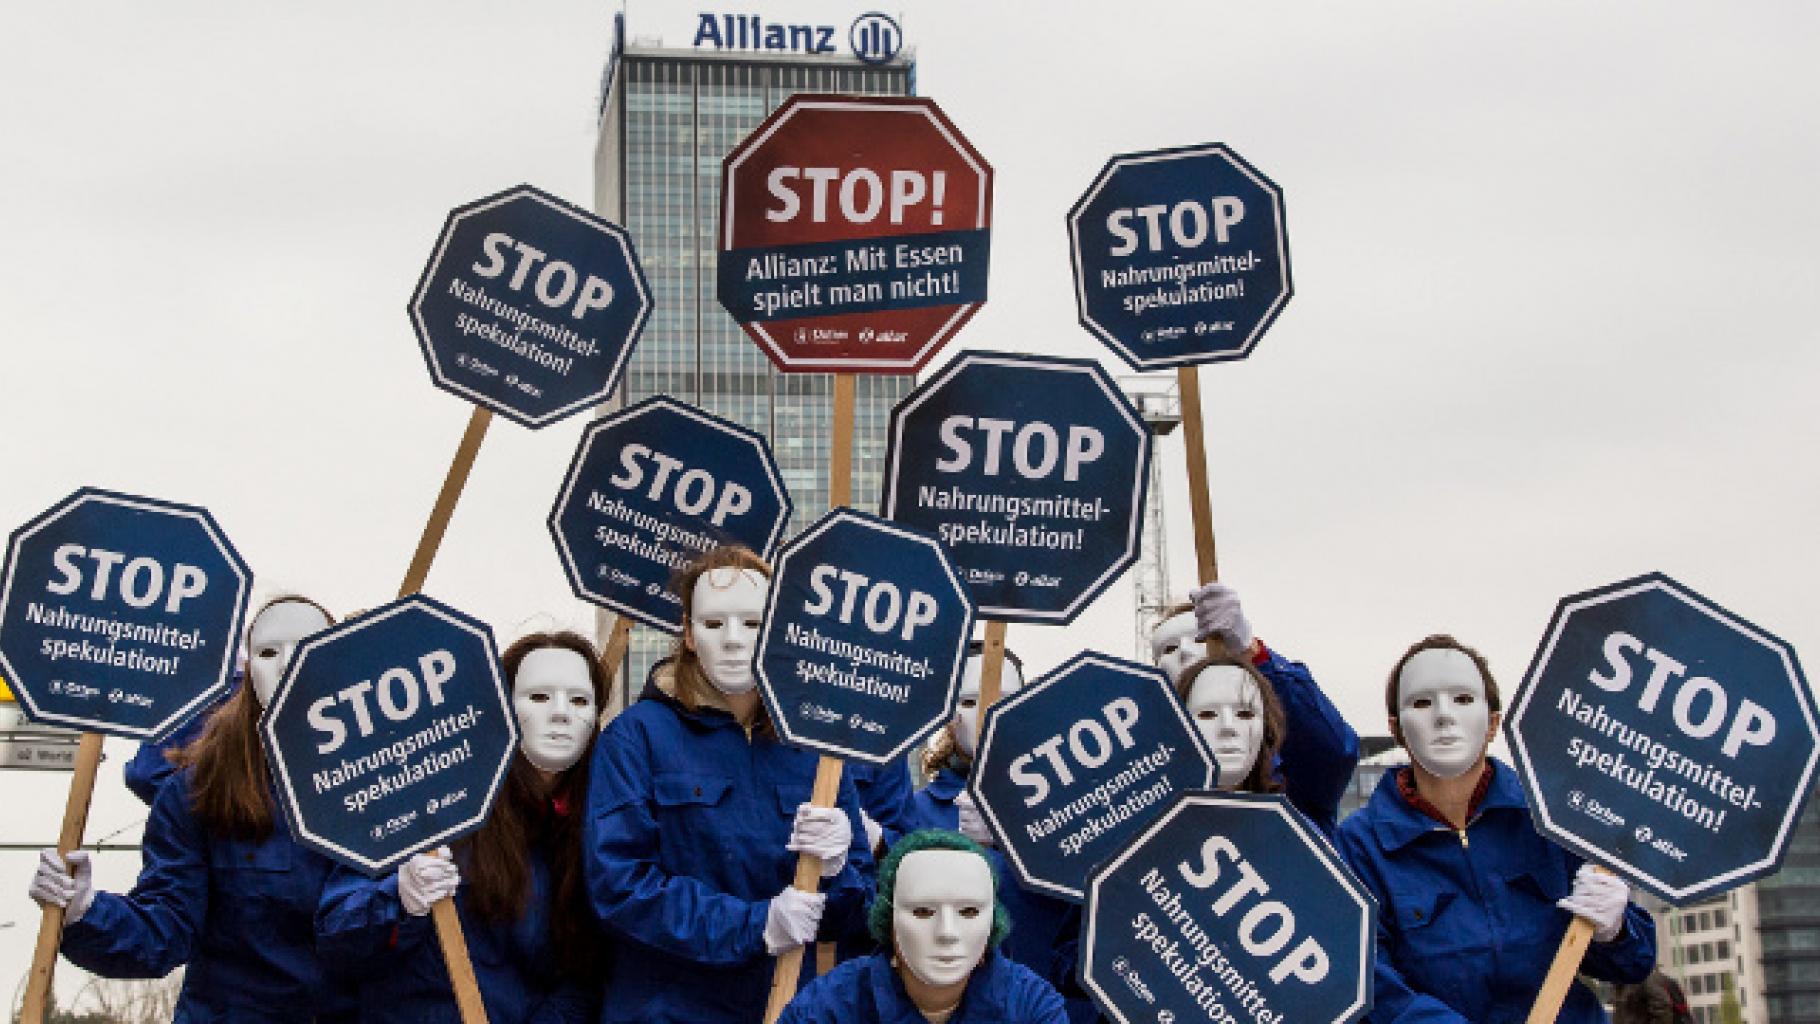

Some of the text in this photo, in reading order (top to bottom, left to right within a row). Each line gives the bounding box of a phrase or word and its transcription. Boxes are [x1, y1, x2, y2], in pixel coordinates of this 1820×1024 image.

[693, 13, 836, 52] Allianz
[765, 166, 946, 226] STOP!
[1106, 195, 1246, 257] STOP
[472, 232, 615, 321] STOP
[745, 243, 963, 282] Allianz: Mit Essen
[752, 270, 960, 316] spielt man nicht!
[1101, 250, 1262, 288] Nahrungsmittel-
[448, 278, 600, 358] Nahrungsmittel-
[1123, 279, 1245, 316] spekulation!
[454, 312, 573, 376] spekulation!
[935, 414, 1105, 482] STOP
[609, 443, 752, 527] STOP
[918, 486, 1110, 521] Nahrungsmittel-
[586, 489, 717, 552] Nahrungsmitt
[939, 520, 1084, 551] spekulation!
[47, 543, 208, 614] STOP
[804, 564, 939, 641] STOP
[25, 602, 206, 650] Nahrungsmittel-
[40, 635, 180, 675] spekulation!
[784, 623, 934, 678] Nahrungsmittel-
[306, 648, 457, 755] STOP
[795, 659, 911, 704] spekulation!
[1587, 630, 1778, 759] STOP
[312, 705, 485, 795] Nahrungsmittel-
[343, 741, 473, 813] spekulation!
[1008, 697, 1140, 808] STOP
[1556, 688, 1762, 811] Nahrungsmittel-
[1026, 742, 1176, 843] Nahrungsmittel-
[1058, 776, 1173, 857] spekulation!
[1567, 738, 1727, 833] spekulation!
[1177, 835, 1330, 985] STOP
[1139, 867, 1284, 1024] Nahrungsmittel
